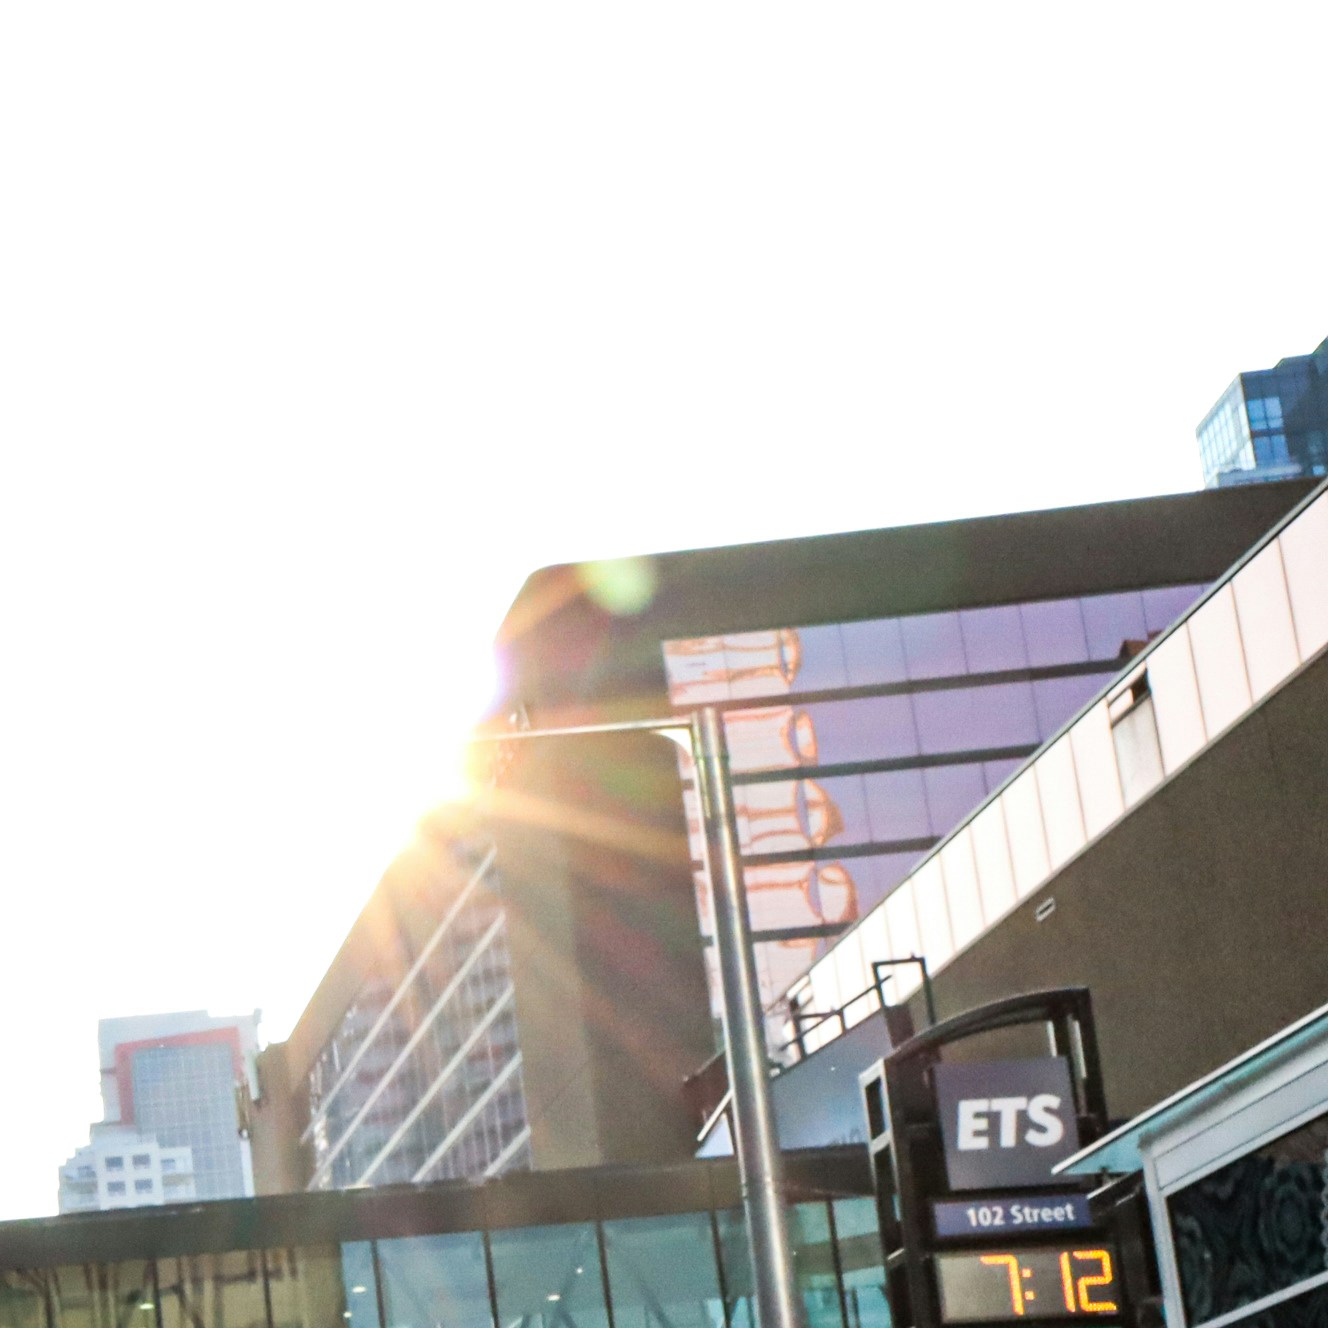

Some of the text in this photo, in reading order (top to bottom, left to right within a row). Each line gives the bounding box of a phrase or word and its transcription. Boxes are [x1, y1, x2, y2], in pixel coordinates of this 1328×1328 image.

[957, 1094, 1064, 1150] ETS
[966, 1202, 1075, 1227] 102 Street
[979, 1249, 1118, 1316] 7:12
